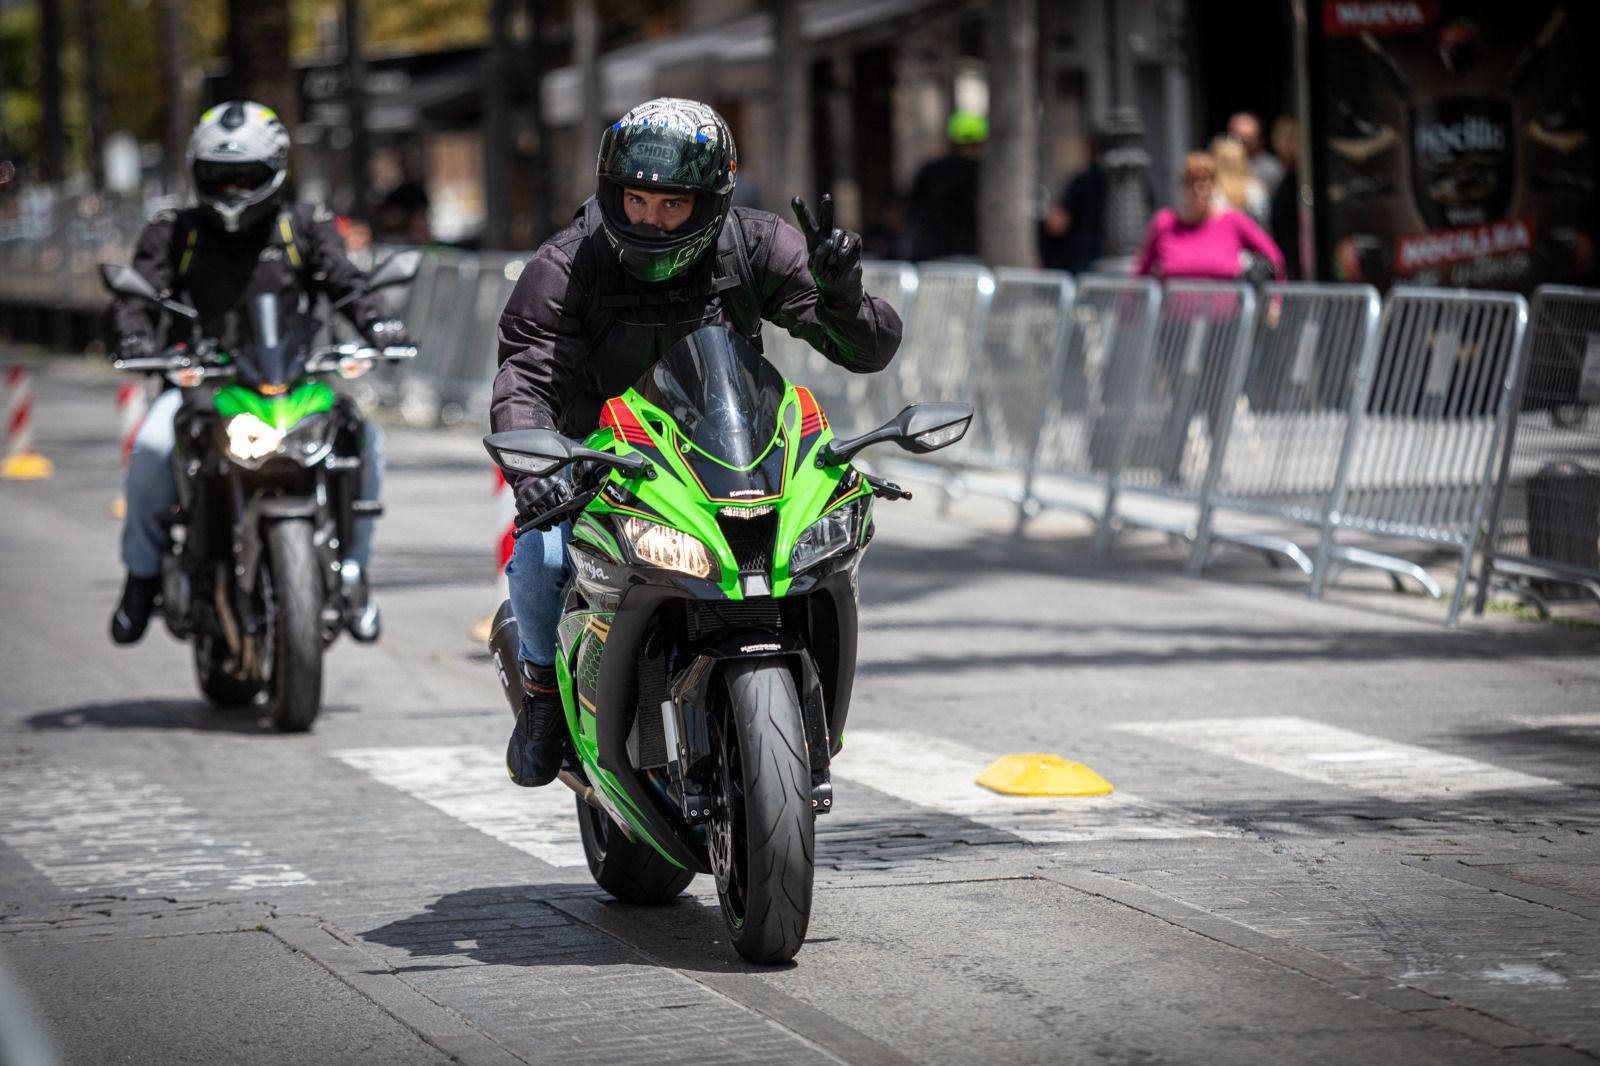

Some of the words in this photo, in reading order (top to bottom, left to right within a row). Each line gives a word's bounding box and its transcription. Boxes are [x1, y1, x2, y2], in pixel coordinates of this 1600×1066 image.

[1337, 3, 1423, 26] NUEVA
[647, 119, 664, 128] YOU
[667, 120, 697, 137] WINGS
[637, 144, 674, 160] SHOEI
